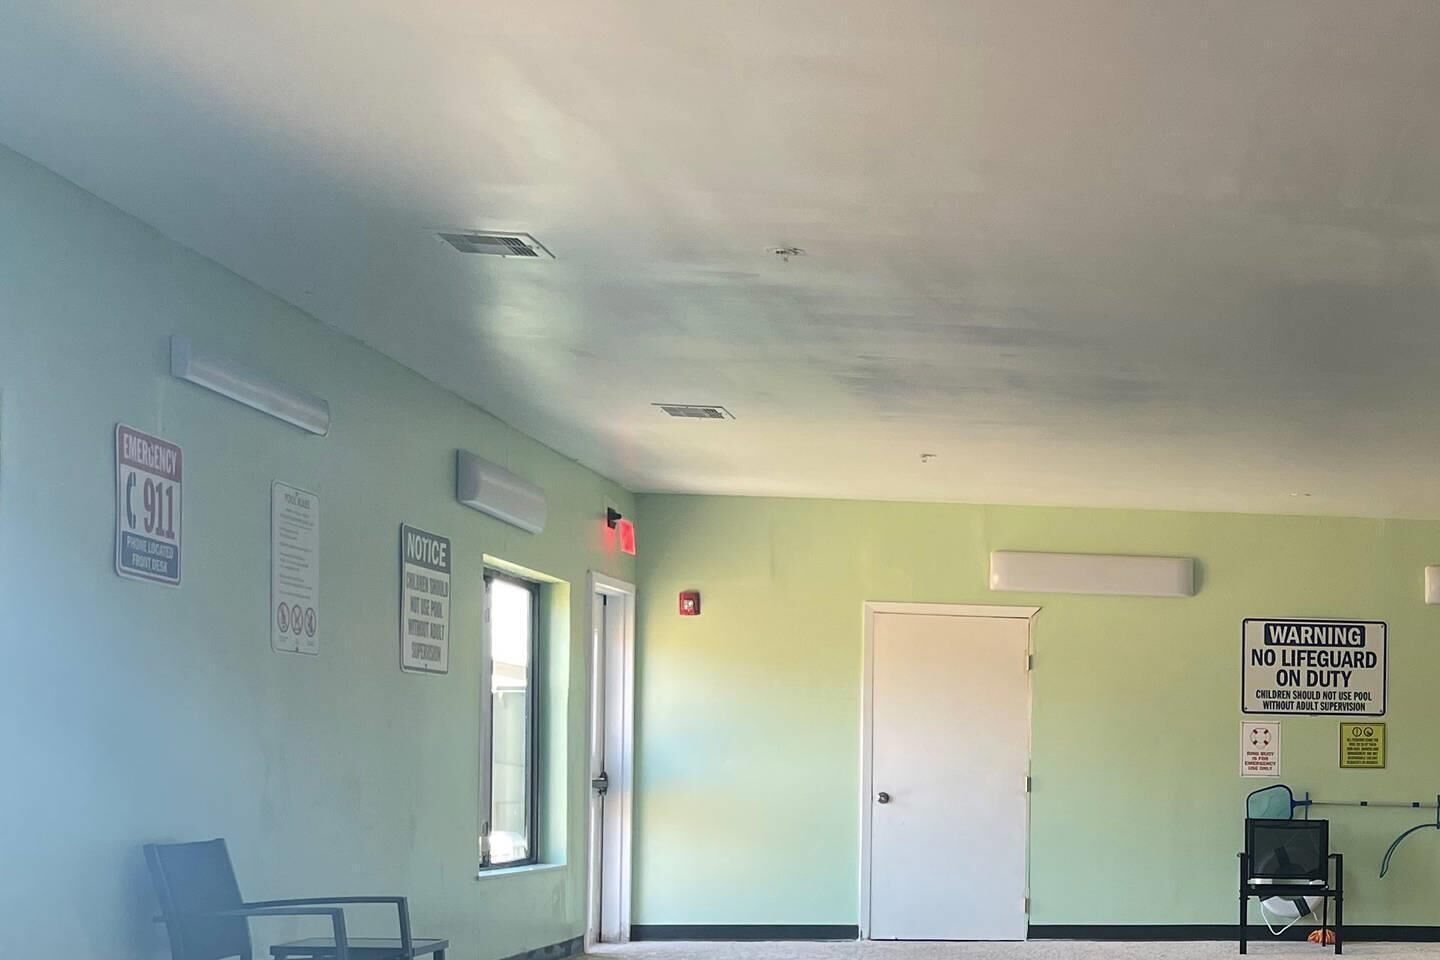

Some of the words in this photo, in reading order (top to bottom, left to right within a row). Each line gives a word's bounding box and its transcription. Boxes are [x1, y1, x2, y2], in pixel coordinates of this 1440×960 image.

[123, 433, 177, 476] EMERGENCY
[143, 477, 175, 540] 911
[407, 532, 447, 568] NOTICE
[1269, 625, 1361, 646] WARNING
[1251, 649, 1276, 667] NO
[1281, 650, 1377, 669] LIFEGUARD
[1276, 669, 1300, 687] ON
[1306, 670, 1352, 688] DUTY
[1256, 690, 1291, 700] CHILDREN
[1292, 690, 1320, 700] SHOULD
[1322, 691, 1337, 701] NOT
[1338, 691, 1352, 701] USE
[1353, 691, 1372, 701] POOL
[1263, 700, 1294, 711] WITHOUT
[1296, 701, 1318, 711] ADULT
[1320, 701, 1366, 712] SUPERVISION
